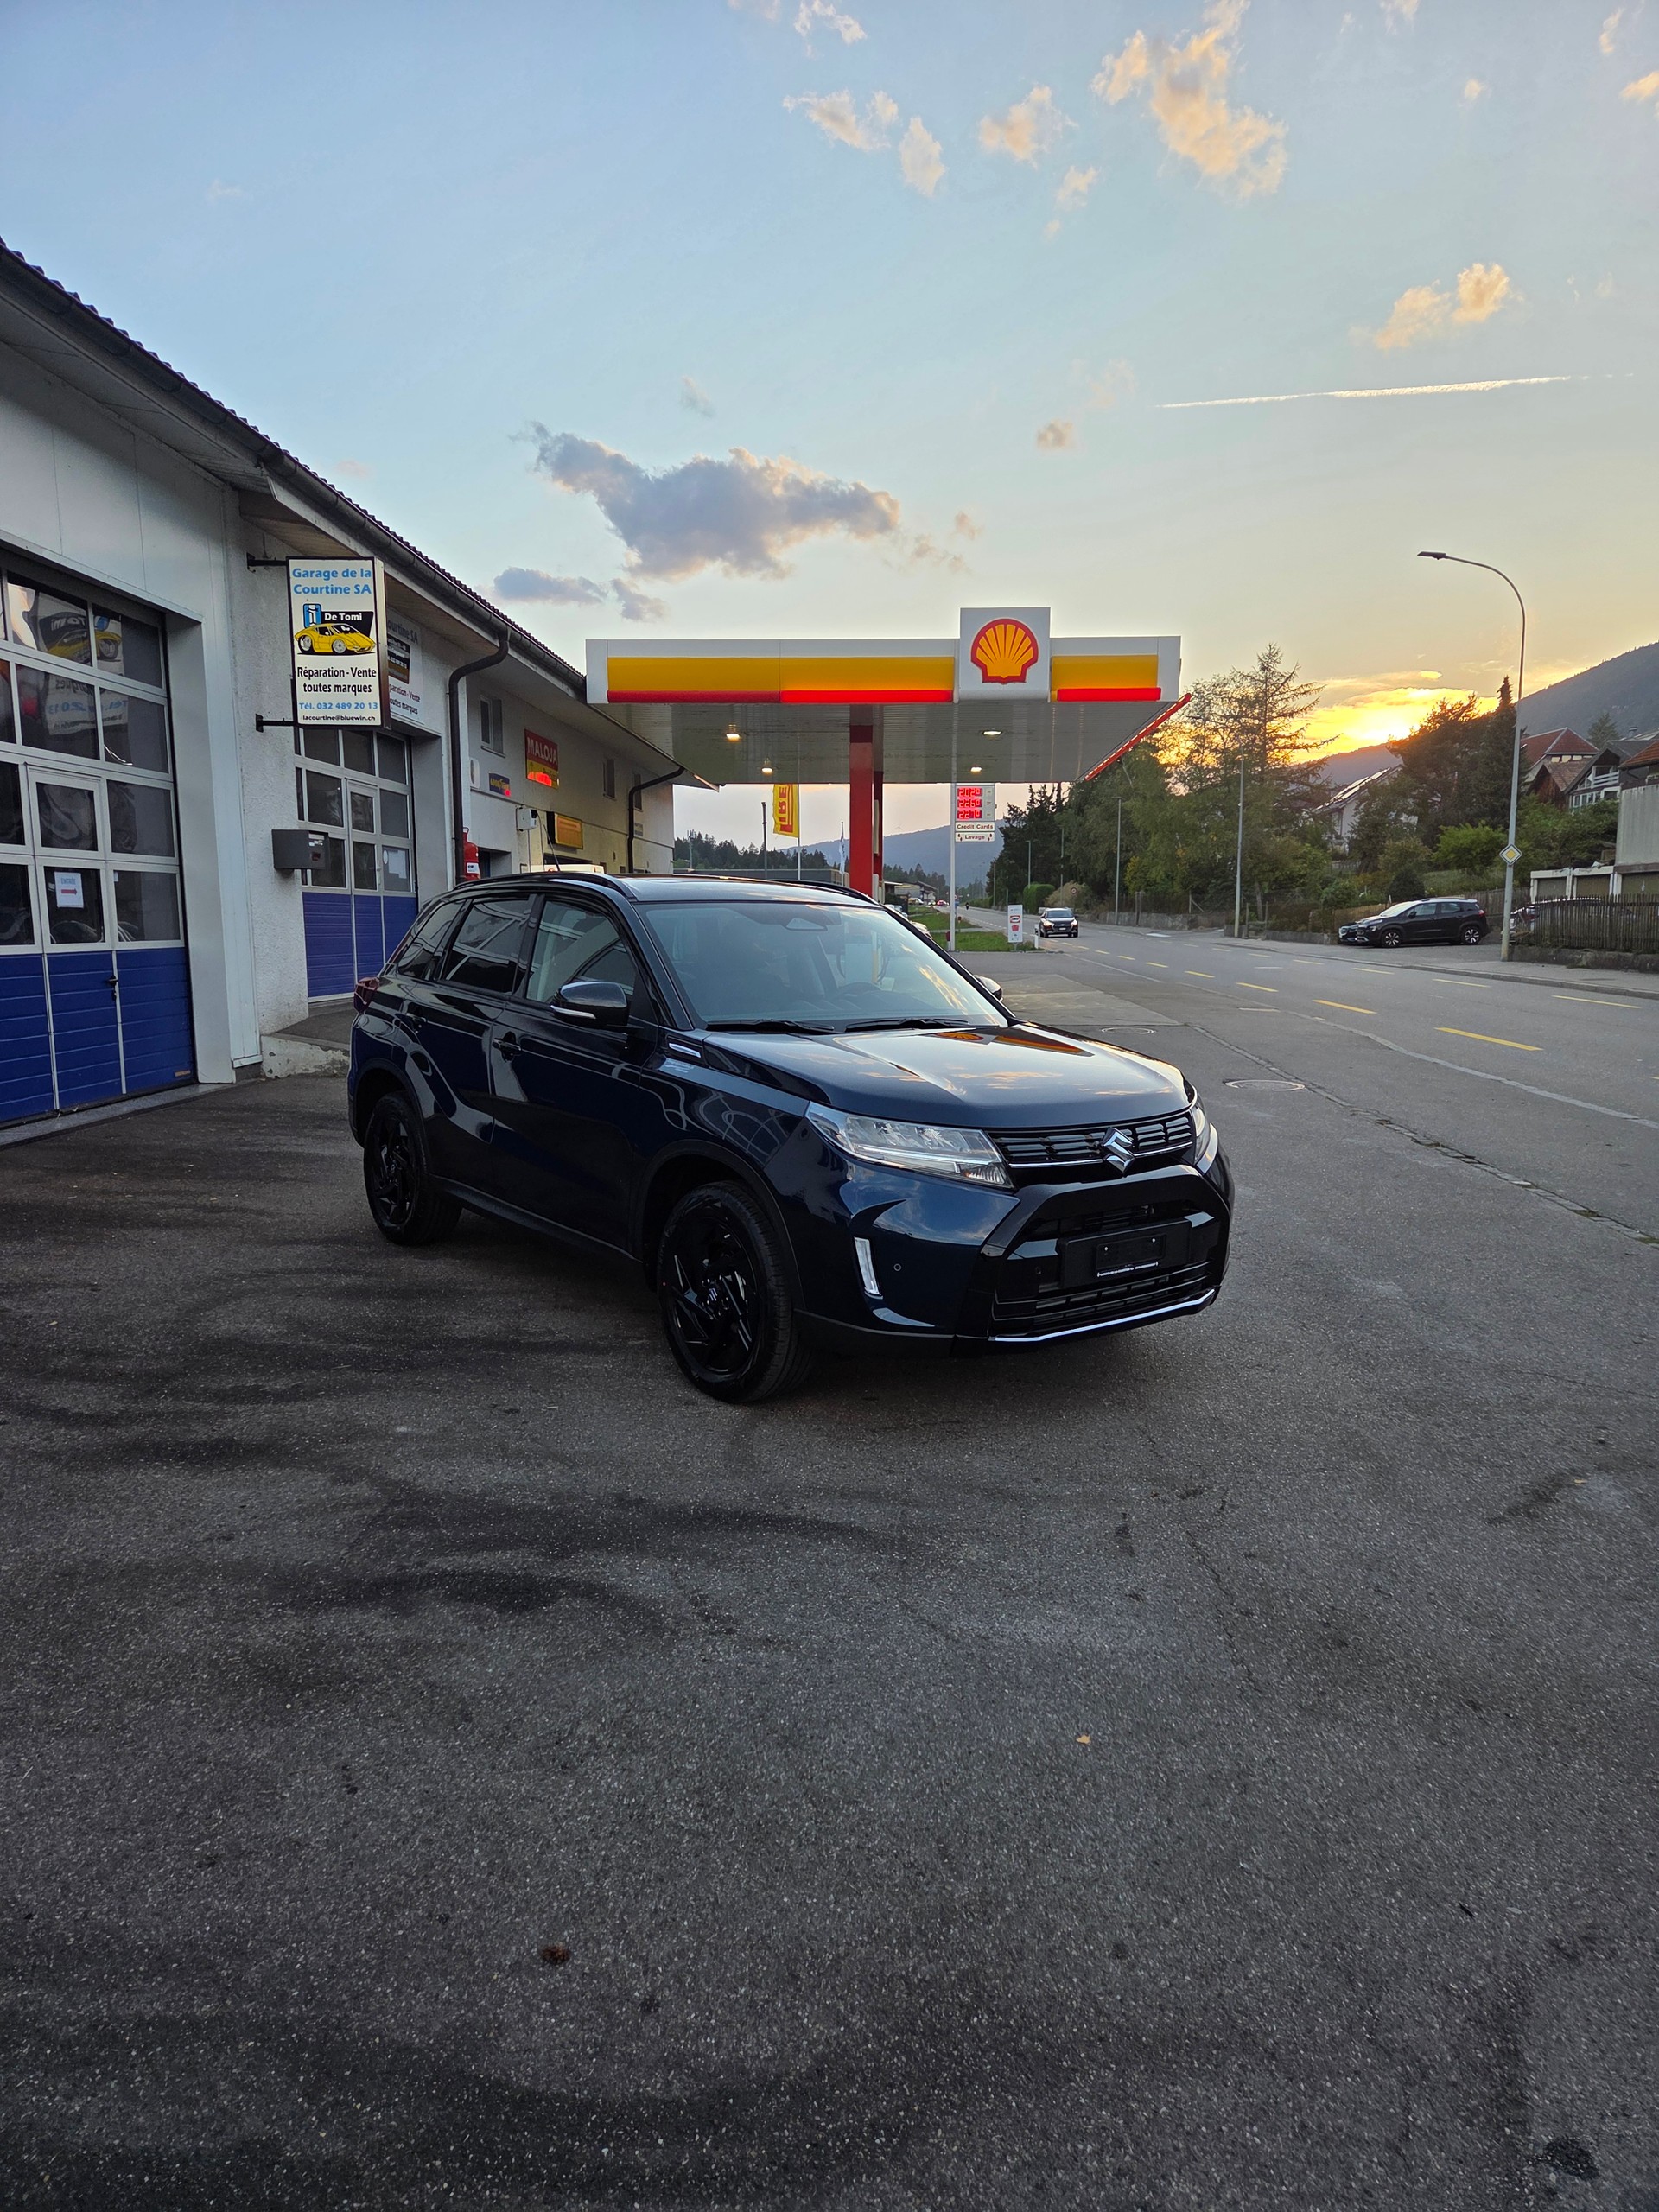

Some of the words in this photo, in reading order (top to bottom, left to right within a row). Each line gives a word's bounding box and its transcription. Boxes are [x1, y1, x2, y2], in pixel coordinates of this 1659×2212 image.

[292, 568, 338, 581] Garage
[341, 568, 357, 578] de
[360, 568, 372, 578] la
[294, 584, 350, 594] Courtine
[353, 584, 372, 594] SA
[324, 613, 338, 621] De
[339, 613, 362, 621] Tomi
[297, 666, 345, 680] Réparation
[350, 667, 377, 677] Vente
[303, 683, 332, 692] toutes
[334, 683, 372, 696] marques
[526, 736, 557, 765] MALOJA
[779, 784, 793, 833] PIRE
